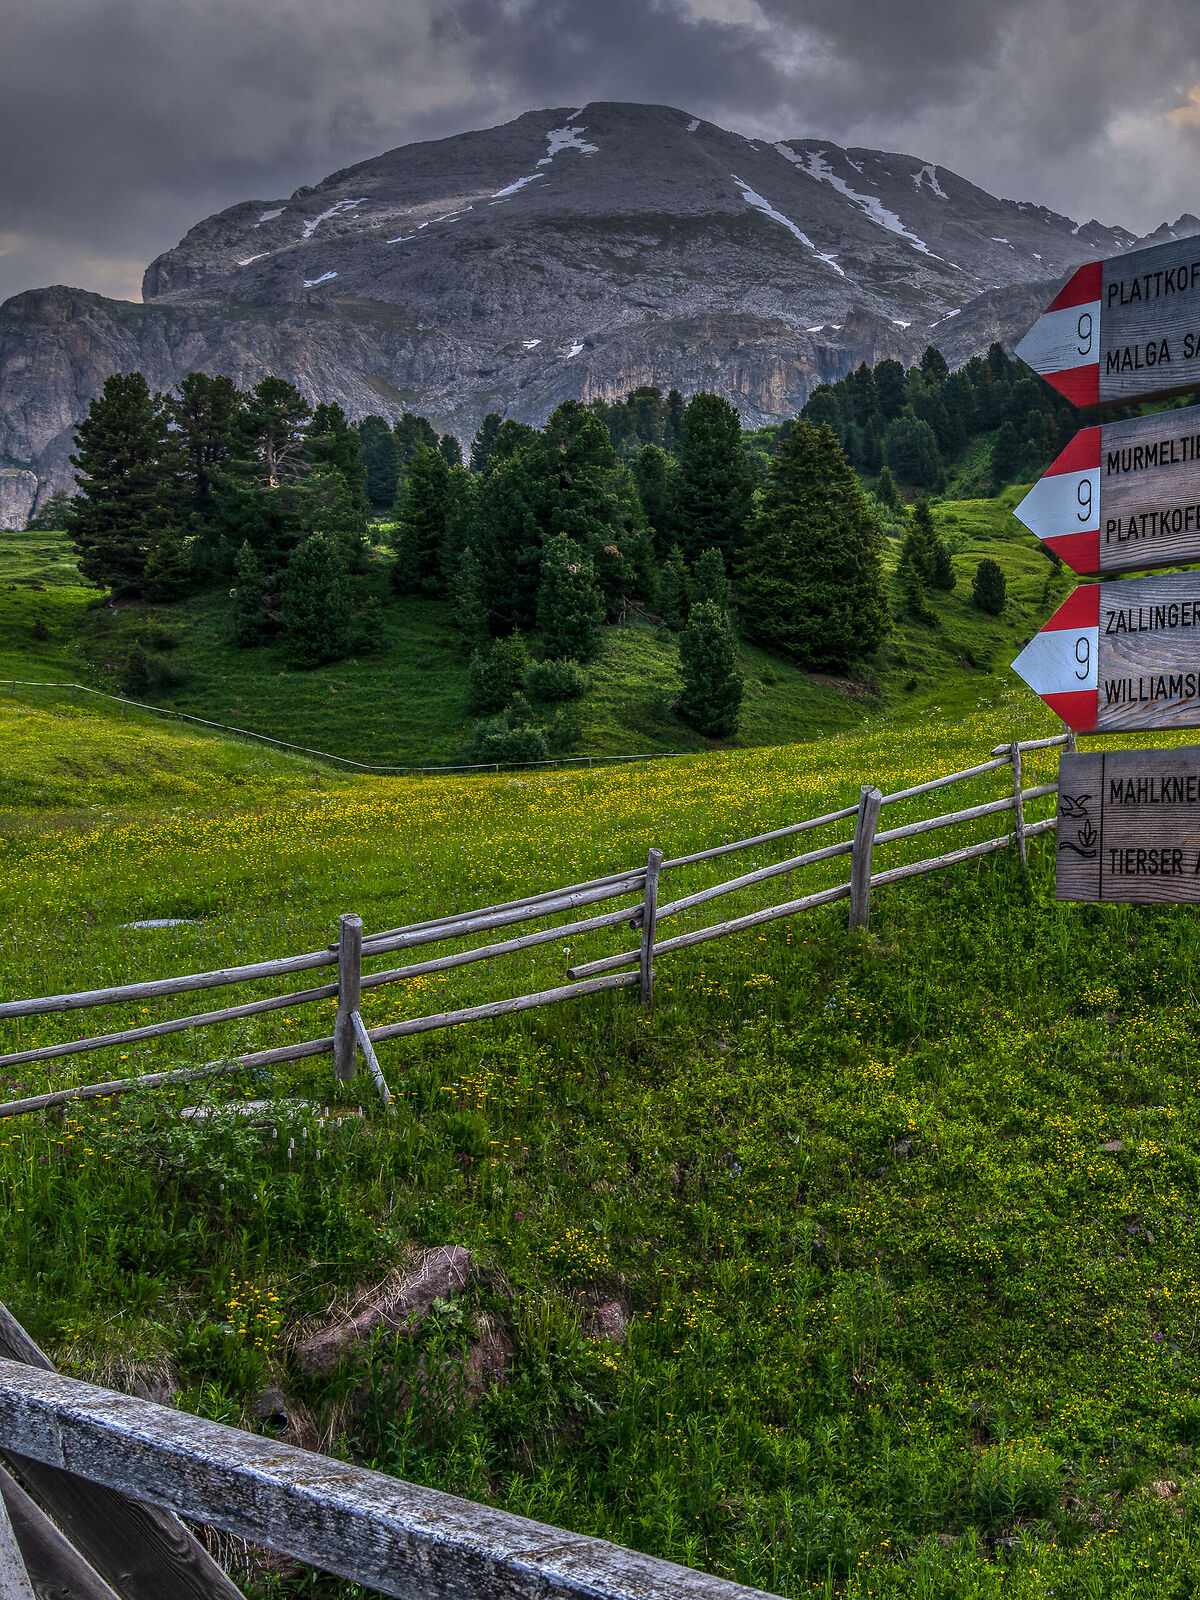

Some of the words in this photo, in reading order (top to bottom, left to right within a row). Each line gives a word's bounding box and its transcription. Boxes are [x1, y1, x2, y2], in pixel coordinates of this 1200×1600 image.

[1077, 313, 1093, 355] 9
[1106, 339, 1171, 375] MALGA
[1077, 479, 1092, 522] 9
[1075, 636, 1090, 681] 9
[1109, 848, 1183, 876] TIERSER
